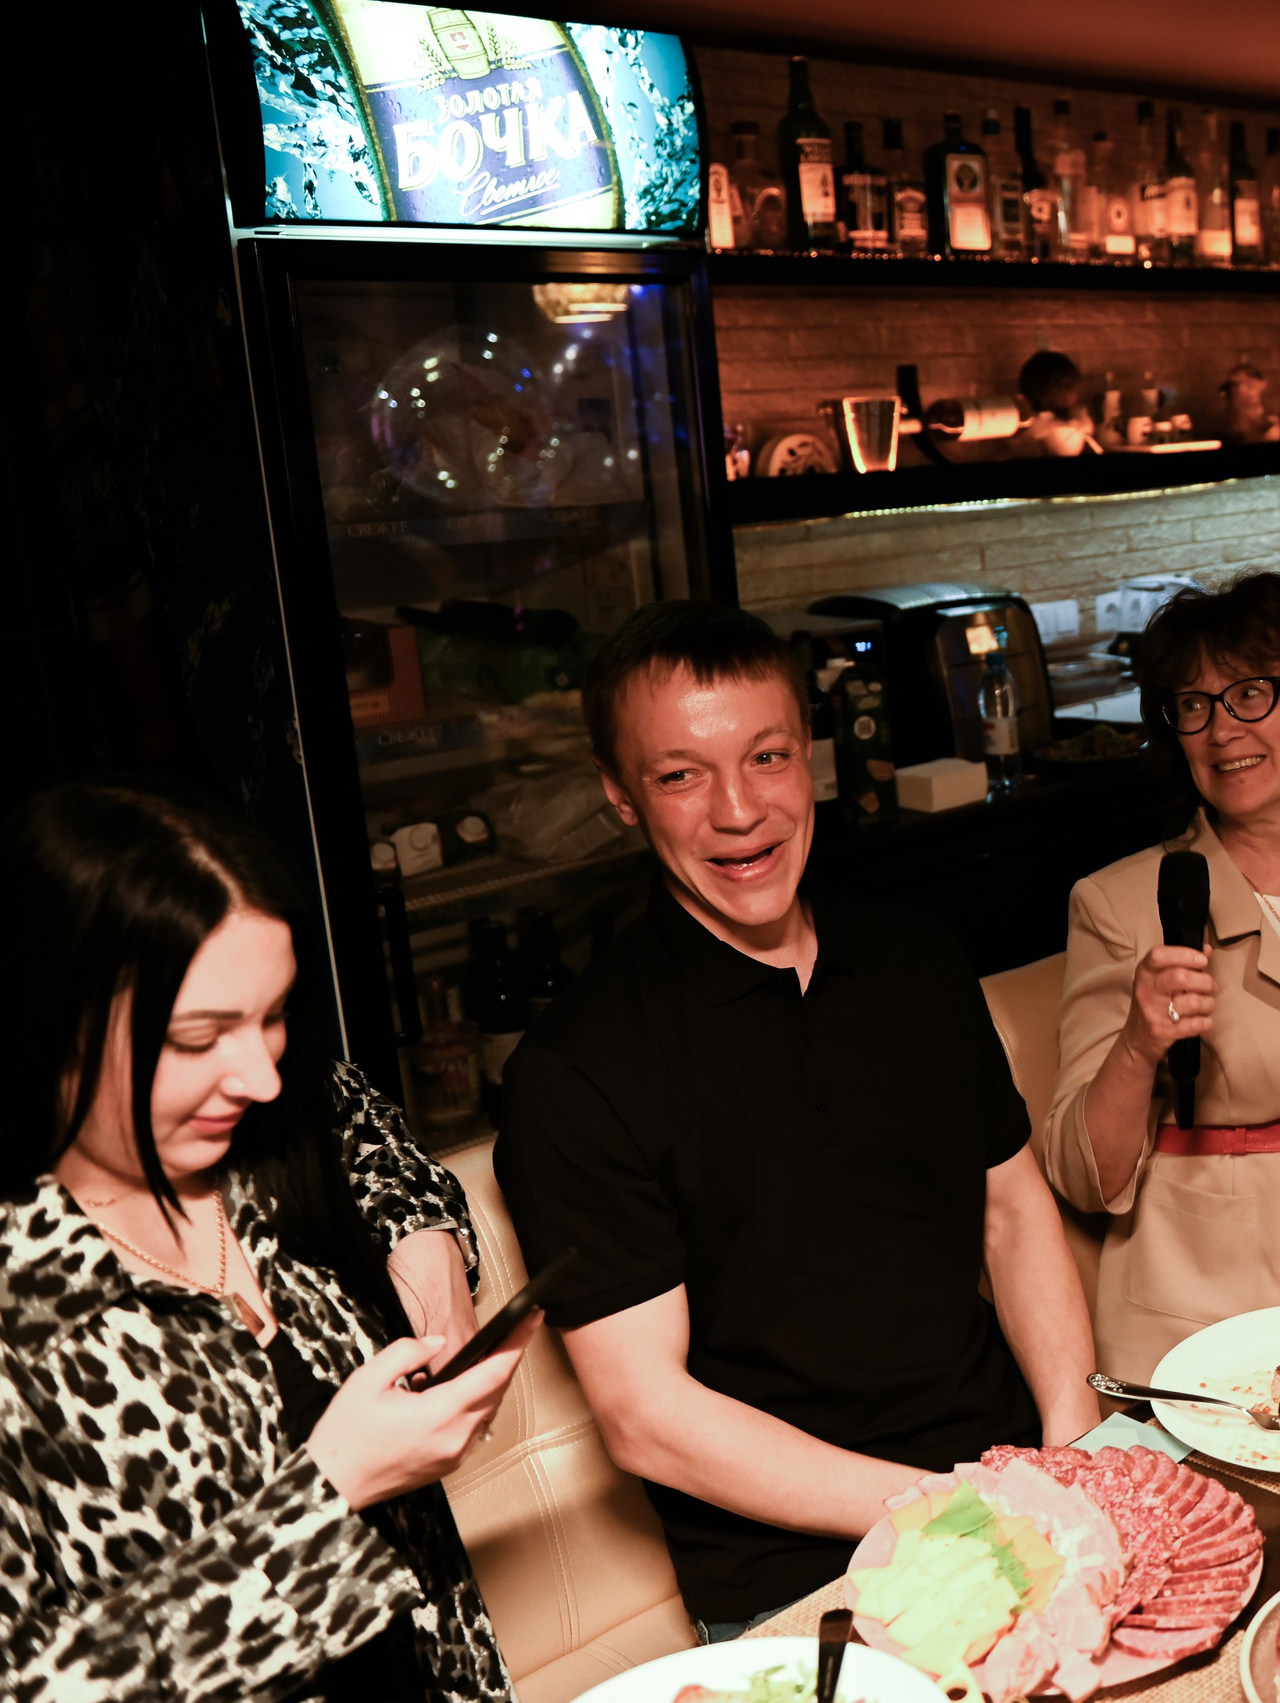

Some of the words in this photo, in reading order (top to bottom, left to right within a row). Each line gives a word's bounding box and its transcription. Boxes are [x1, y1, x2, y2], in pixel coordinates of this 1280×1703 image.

[434, 77, 543, 122] ЗОЛОТАЯ
[393, 90, 600, 191] БОЧКА
[453, 168, 561, 216] Светлое
